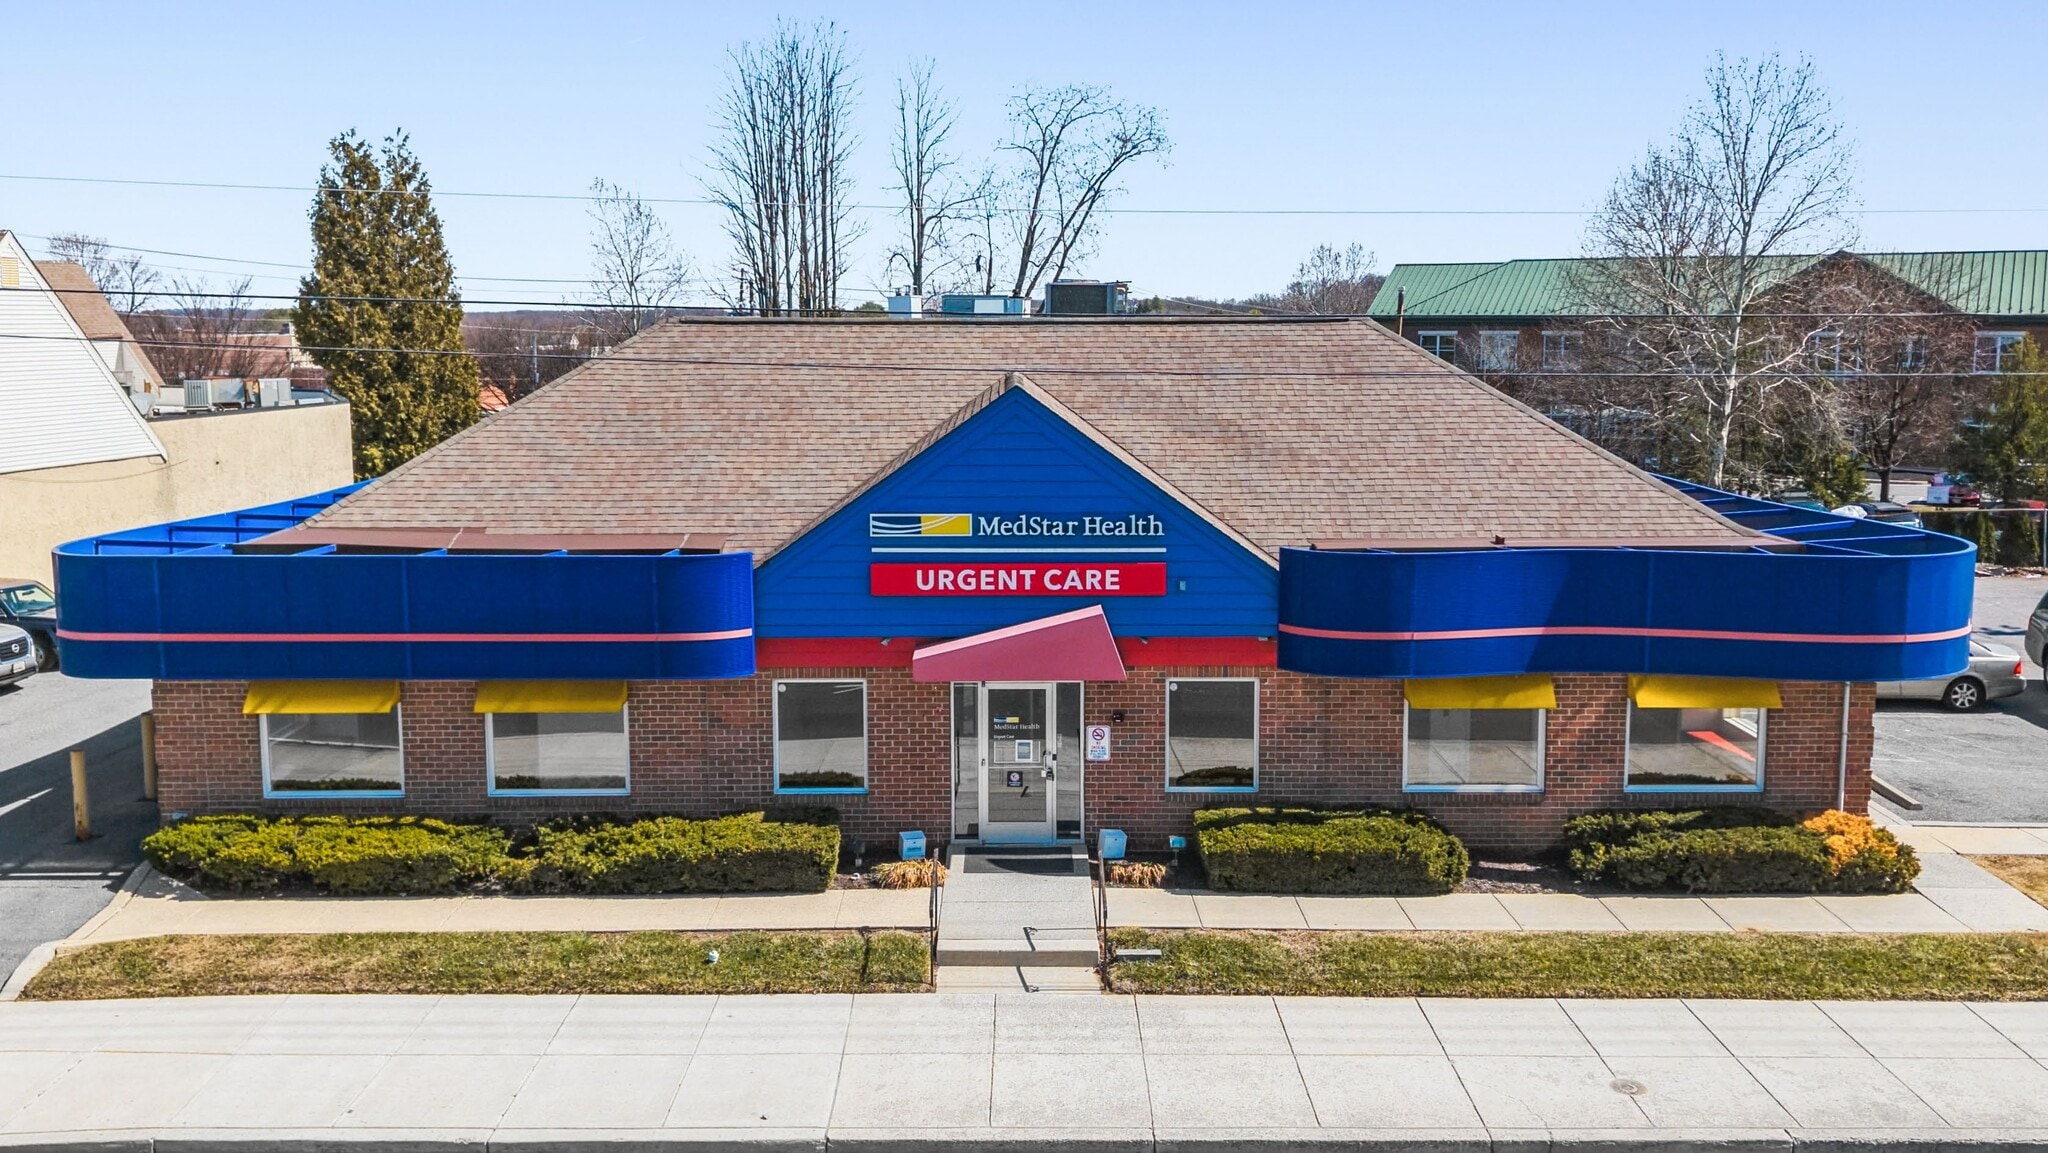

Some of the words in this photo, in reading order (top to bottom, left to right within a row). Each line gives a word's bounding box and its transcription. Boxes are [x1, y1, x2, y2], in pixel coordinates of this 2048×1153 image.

[978, 515, 1081, 536] MedStar
[1083, 515, 1165, 536] Health
[915, 569, 1036, 591] URGENT
[1043, 569, 1121, 591] CARE
